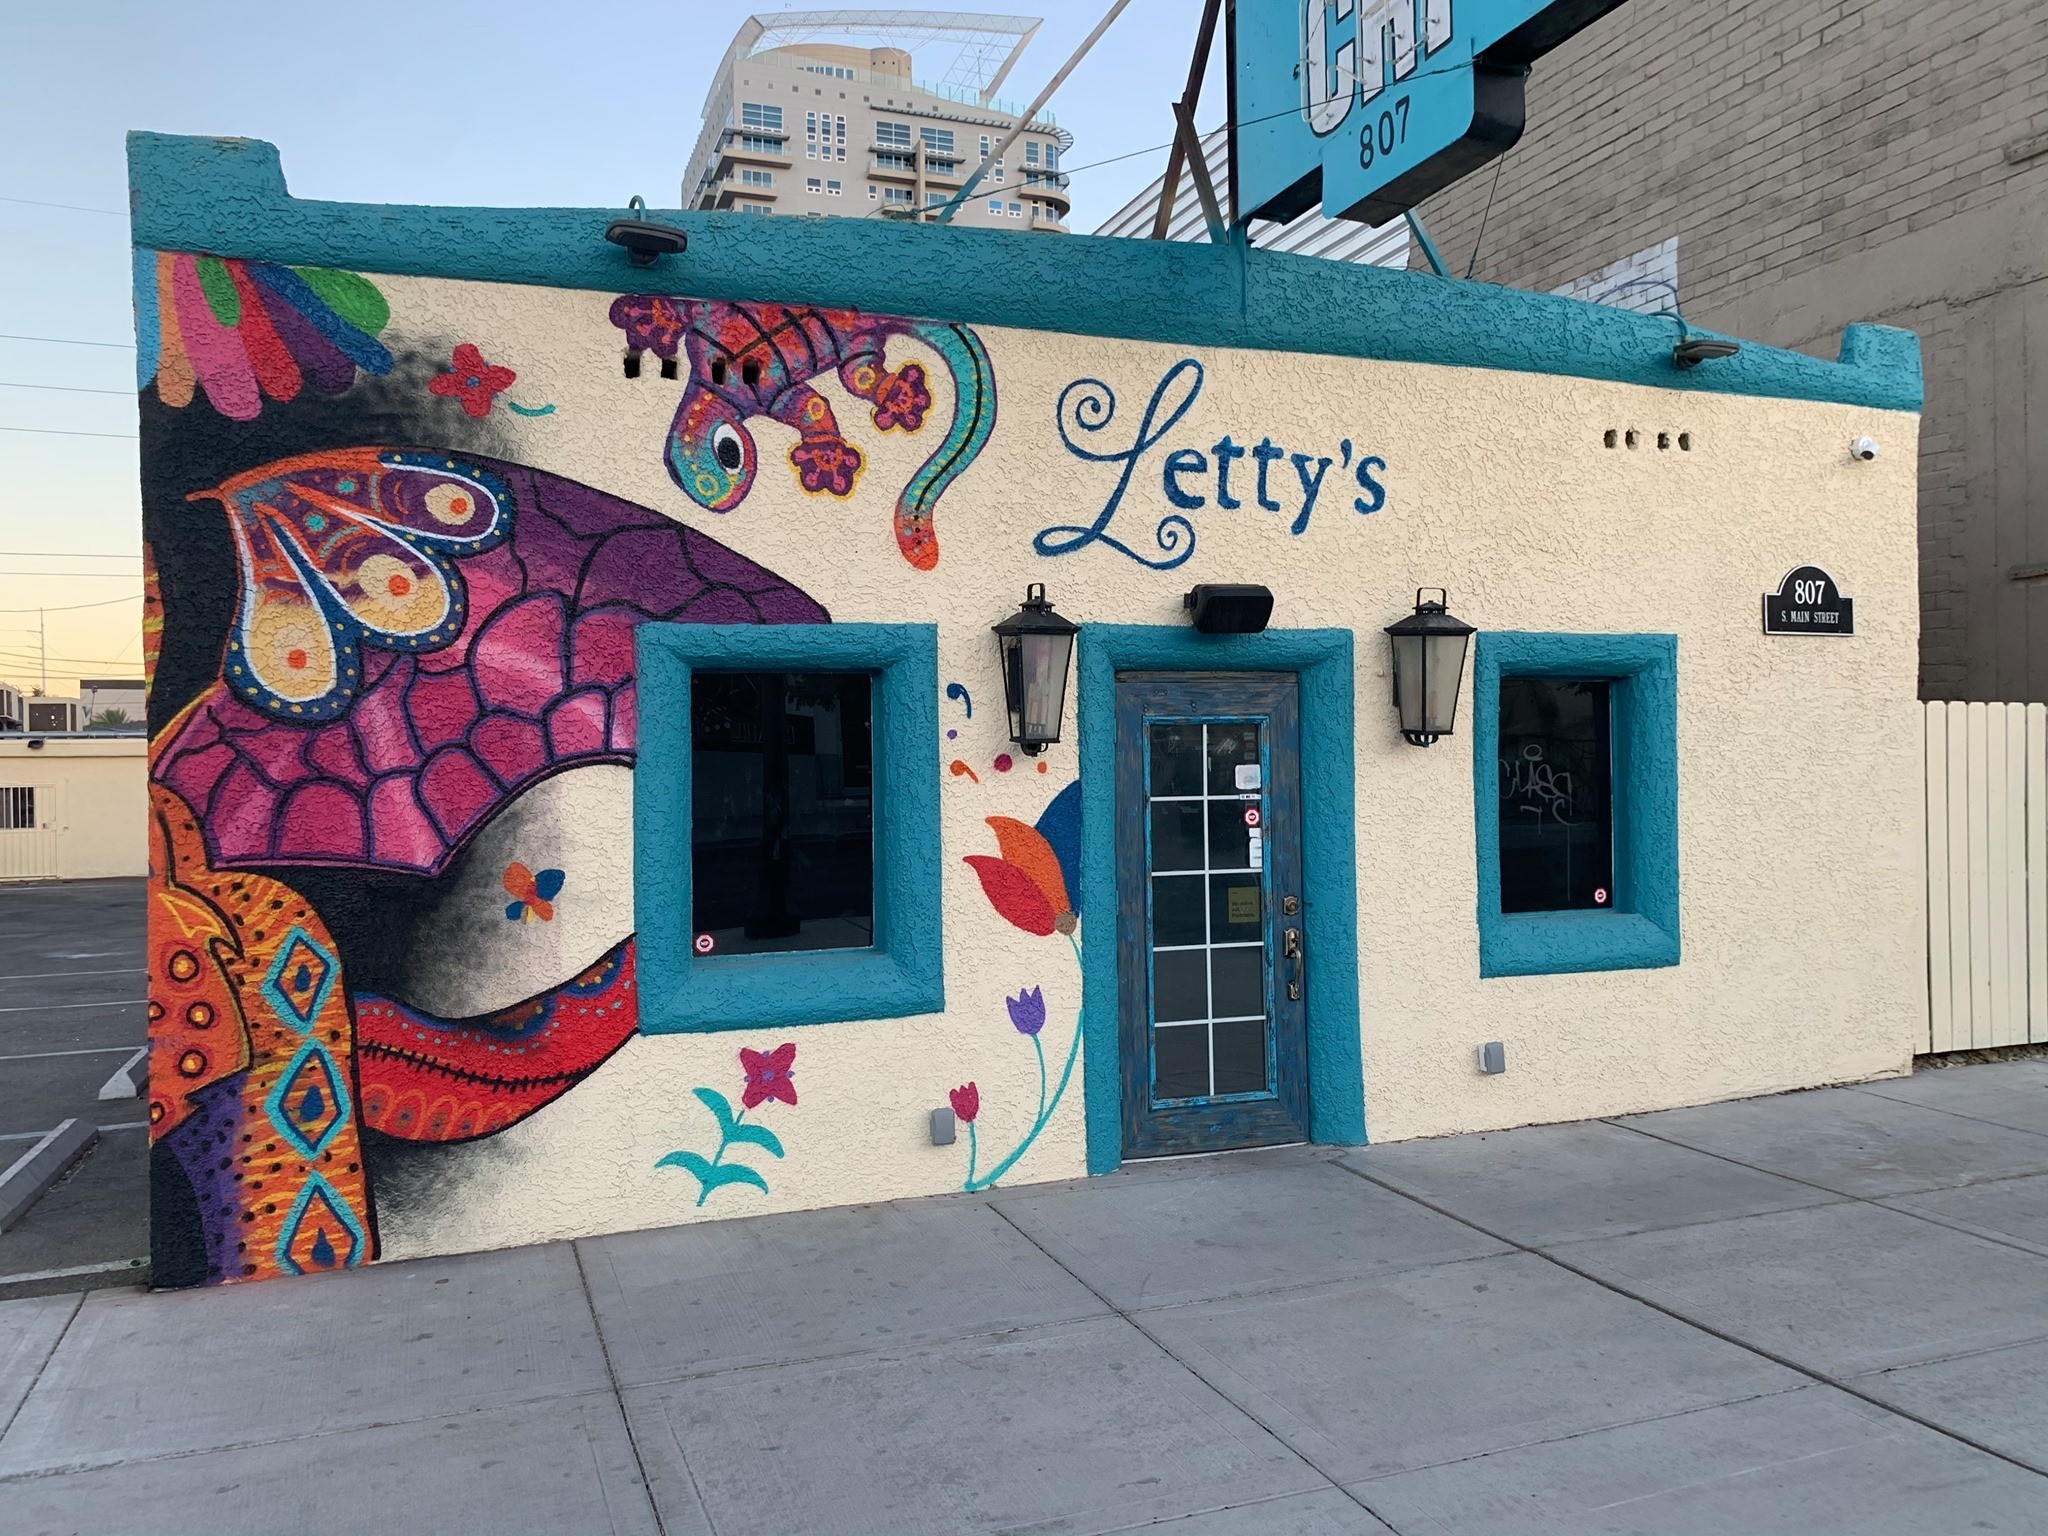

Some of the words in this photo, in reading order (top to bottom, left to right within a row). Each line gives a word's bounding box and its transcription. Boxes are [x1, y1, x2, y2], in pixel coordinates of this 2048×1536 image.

[1359, 95, 1410, 170] 807
[1033, 358, 1388, 570] Letty's
[1781, 610, 1788, 623] S.
[1790, 610, 1810, 623] MAIN
[1813, 612, 1839, 624] STREET
[1794, 579, 1826, 605] 807
